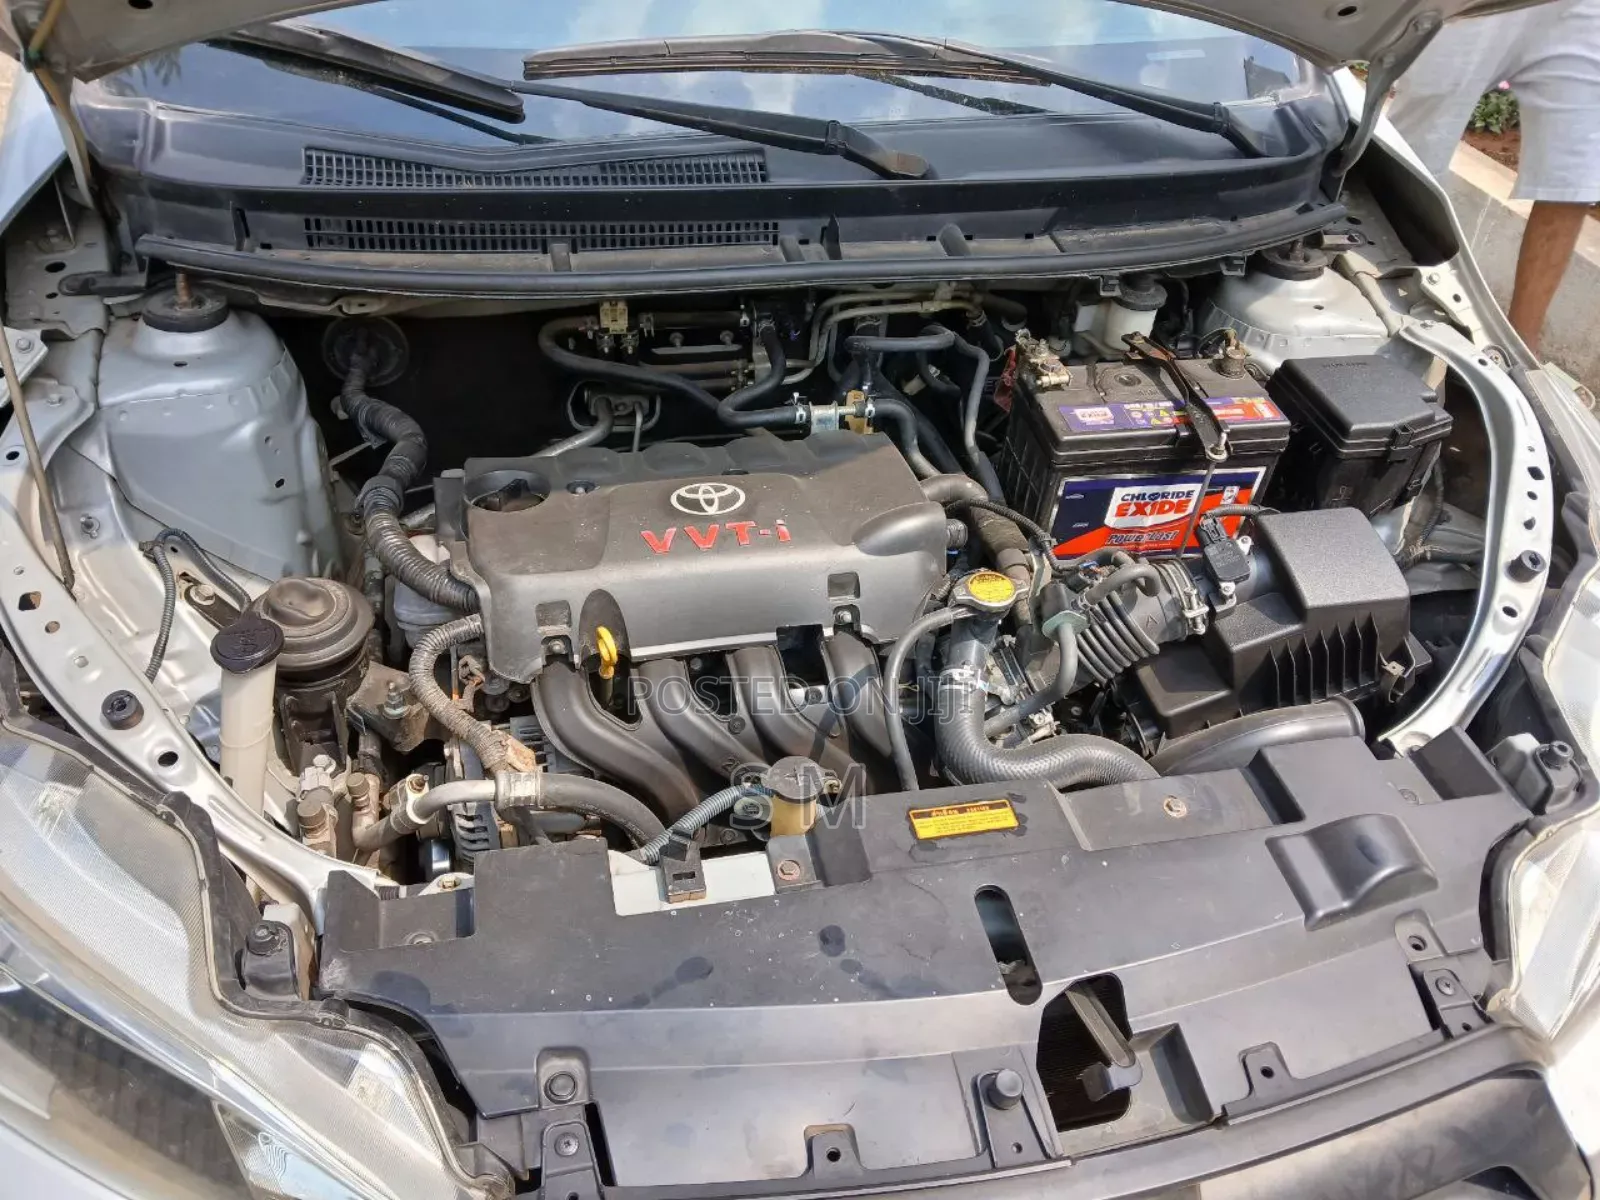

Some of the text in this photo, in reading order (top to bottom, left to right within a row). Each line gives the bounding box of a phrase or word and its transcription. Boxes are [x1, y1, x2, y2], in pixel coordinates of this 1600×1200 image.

[1120, 490, 1195, 502] CHLORIDE
[1115, 499, 1192, 518] EXIDE
[640, 519, 792, 555] VVT-i
